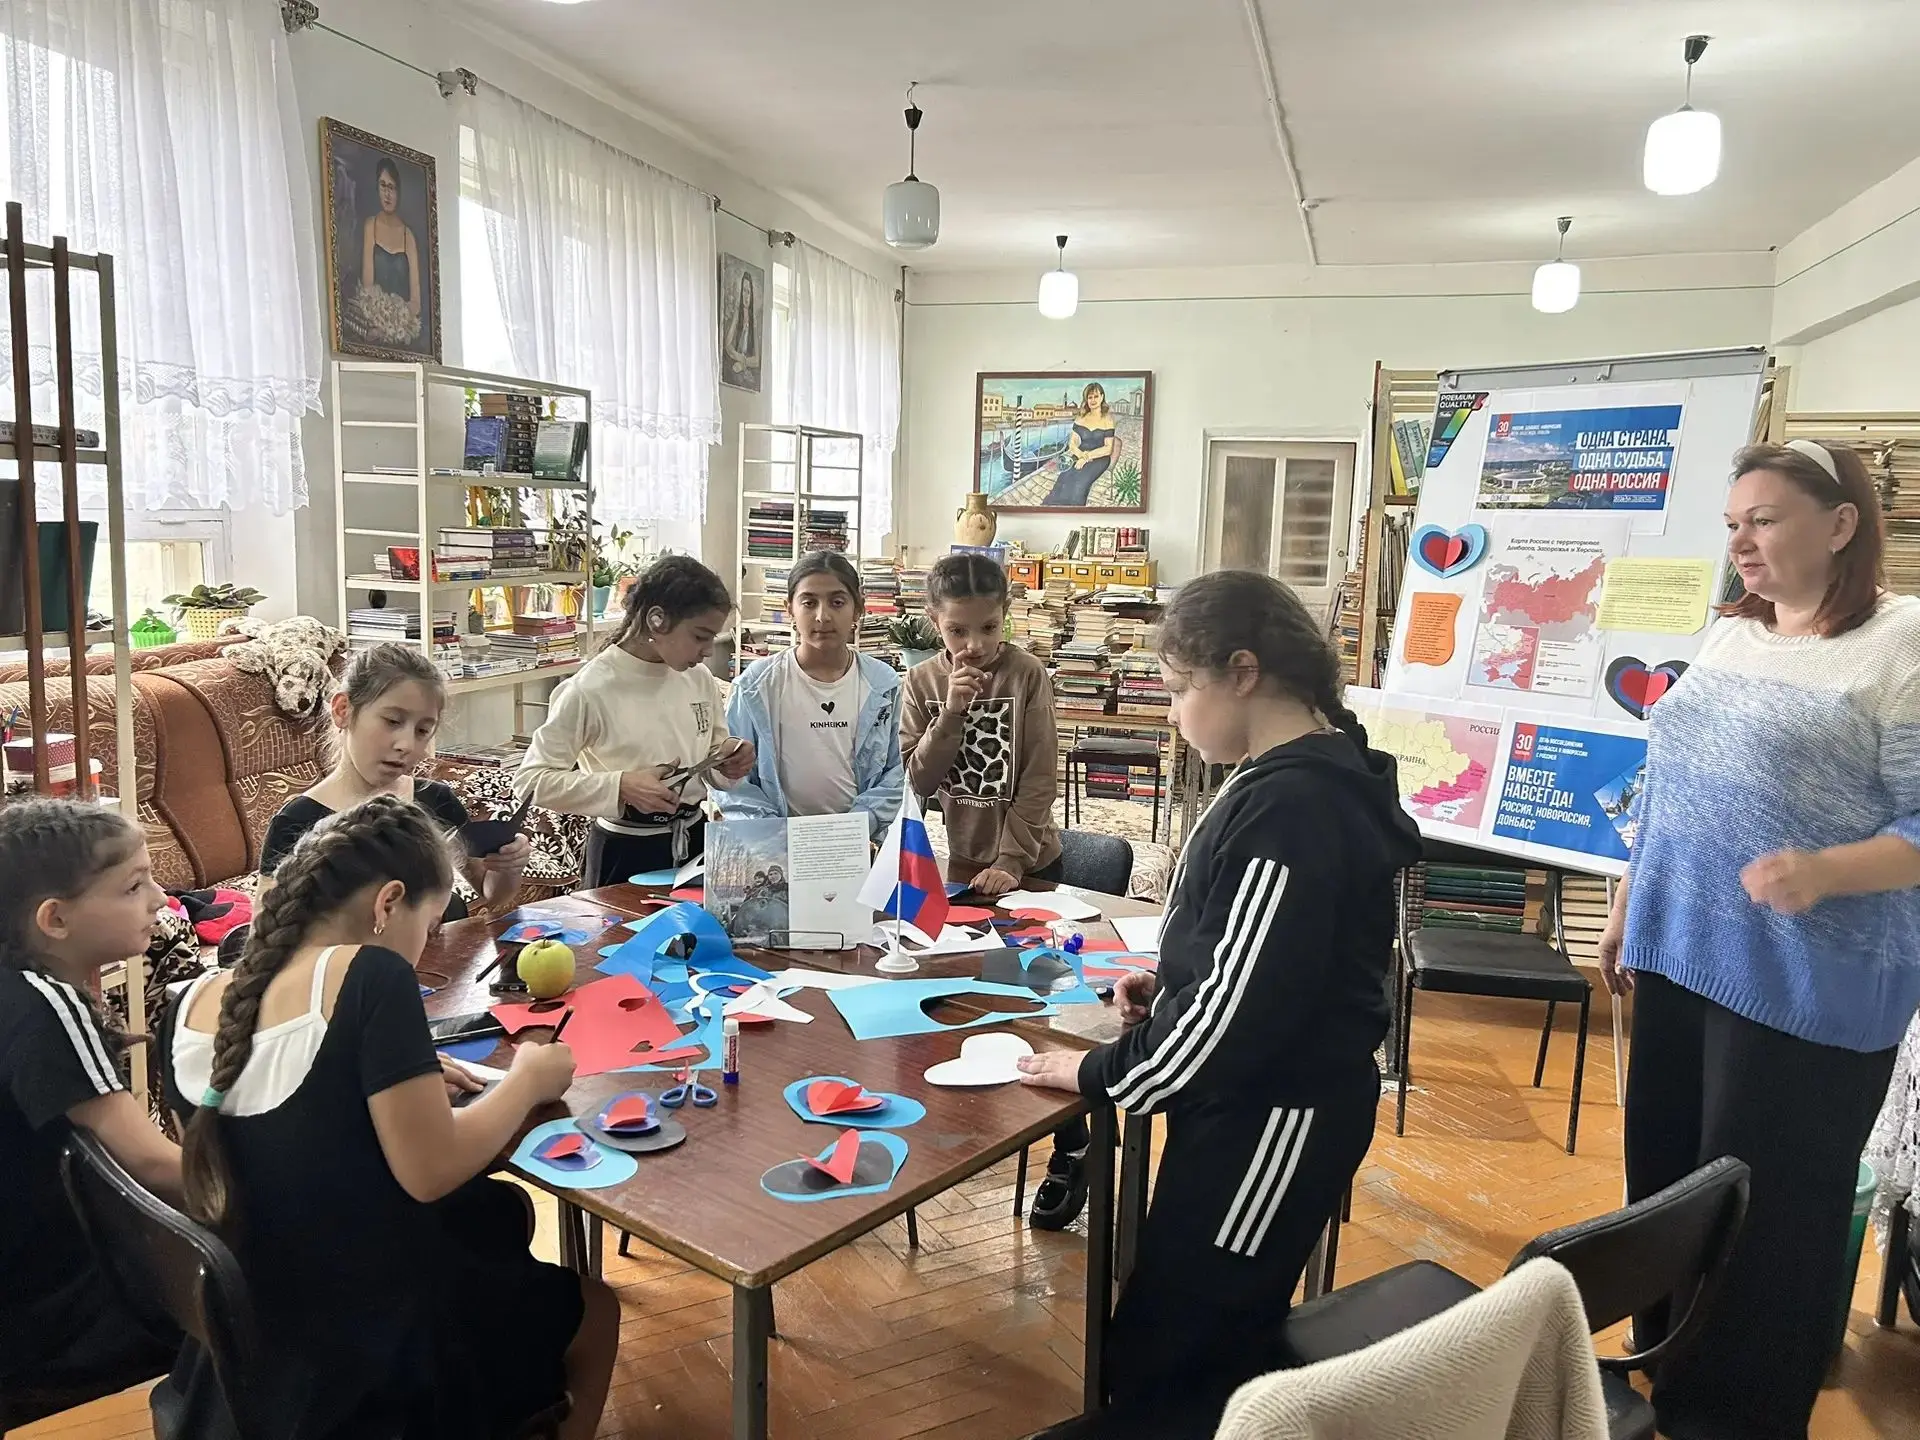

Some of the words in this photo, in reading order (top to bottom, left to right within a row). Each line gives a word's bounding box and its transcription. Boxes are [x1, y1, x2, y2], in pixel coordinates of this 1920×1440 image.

[1440, 401, 1473, 409] QUALITY
[1498, 421, 1509, 432] 30
[1580, 431, 1614, 449] ОДНА
[1617, 429, 1671, 447] СТРАНА,
[1578, 452, 1611, 470] ОДНА
[1614, 451, 1666, 469] СУДЬБА,
[1573, 473, 1607, 490] ОДНА
[1610, 472, 1660, 489] РОССИЯ
[1515, 734, 1533, 751] 30
[1507, 765, 1557, 788] ВМЕСТЕ
[1504, 781, 1574, 808] НАВСЕГДА!
[1496, 813, 1537, 830] ДОНБАСС
[1500, 800, 1534, 816] РОССИЯ,
[1535, 806, 1592, 828] НОВОРОССИЯ,
